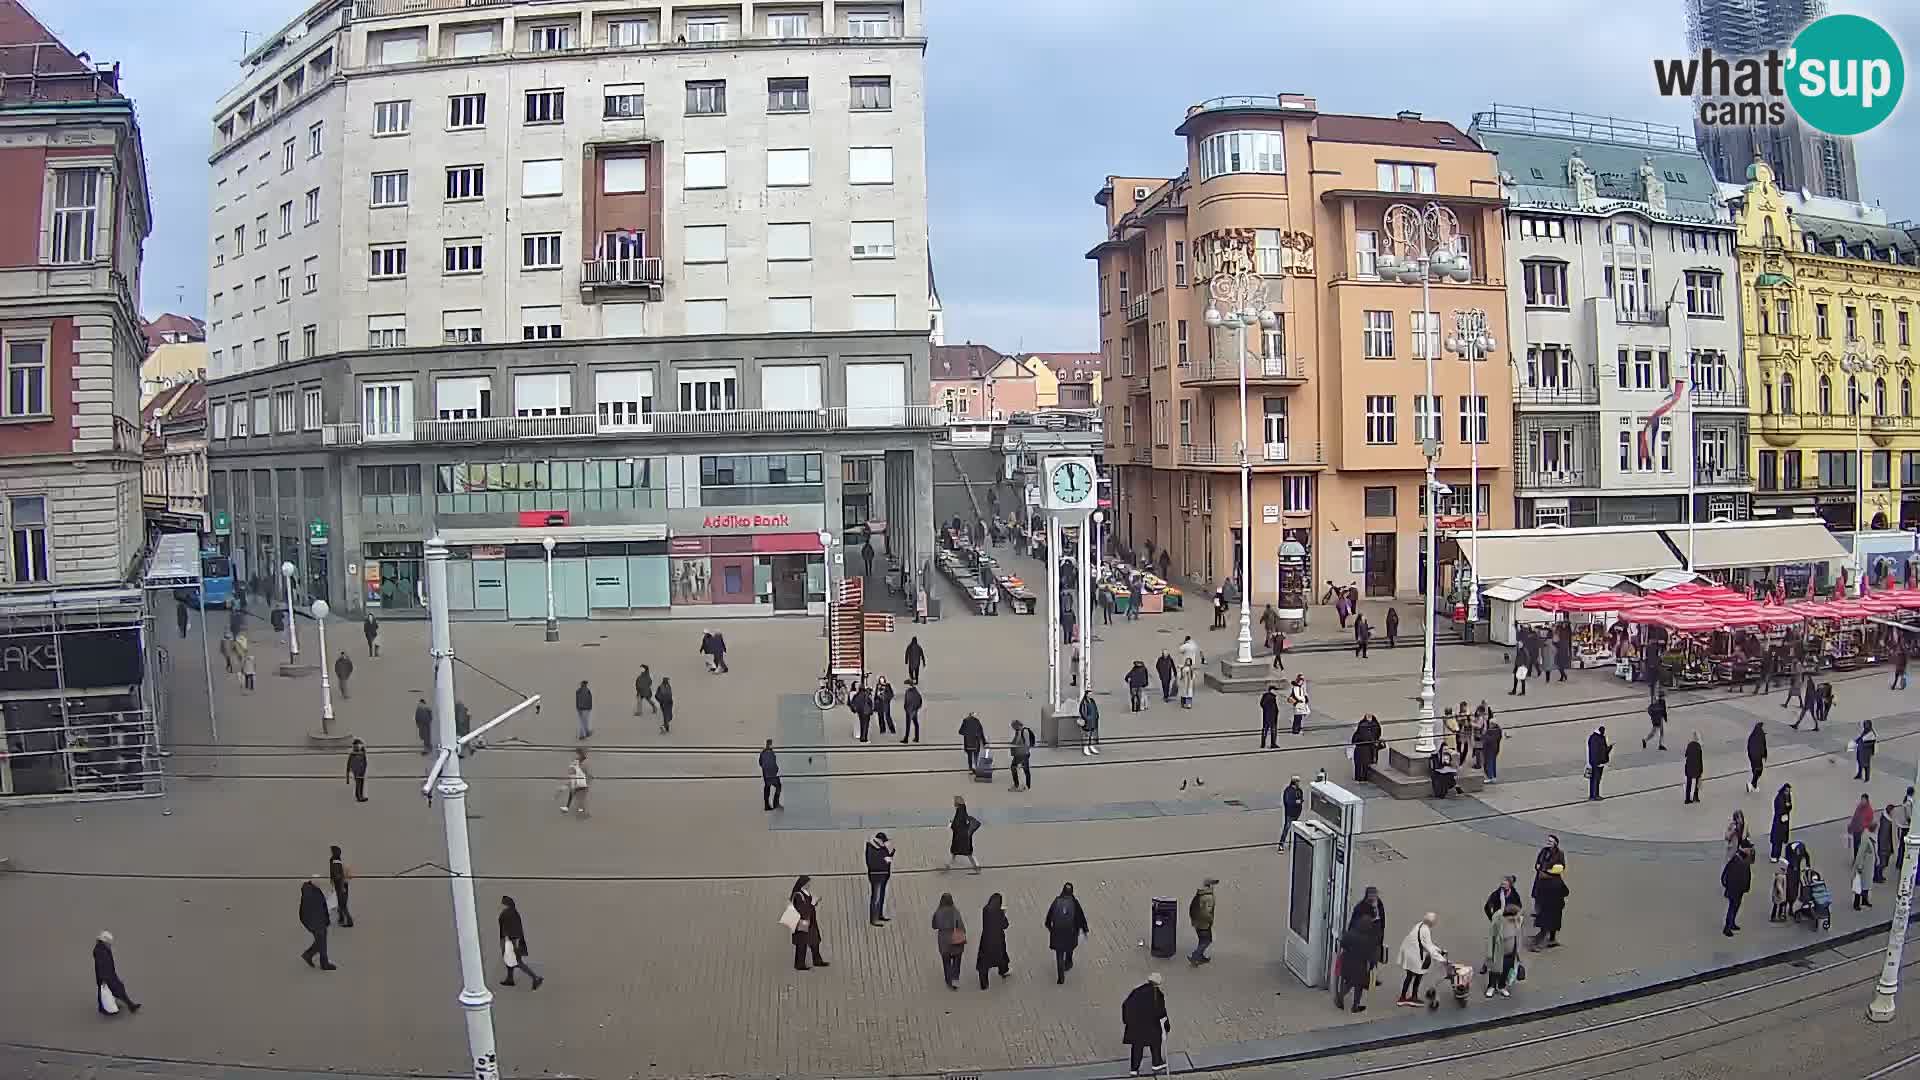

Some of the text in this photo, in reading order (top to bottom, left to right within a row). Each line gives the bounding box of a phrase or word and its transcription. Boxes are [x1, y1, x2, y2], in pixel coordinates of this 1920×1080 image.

[703, 514, 789, 528] Addiko Bank
[0, 644, 61, 671] AKS
